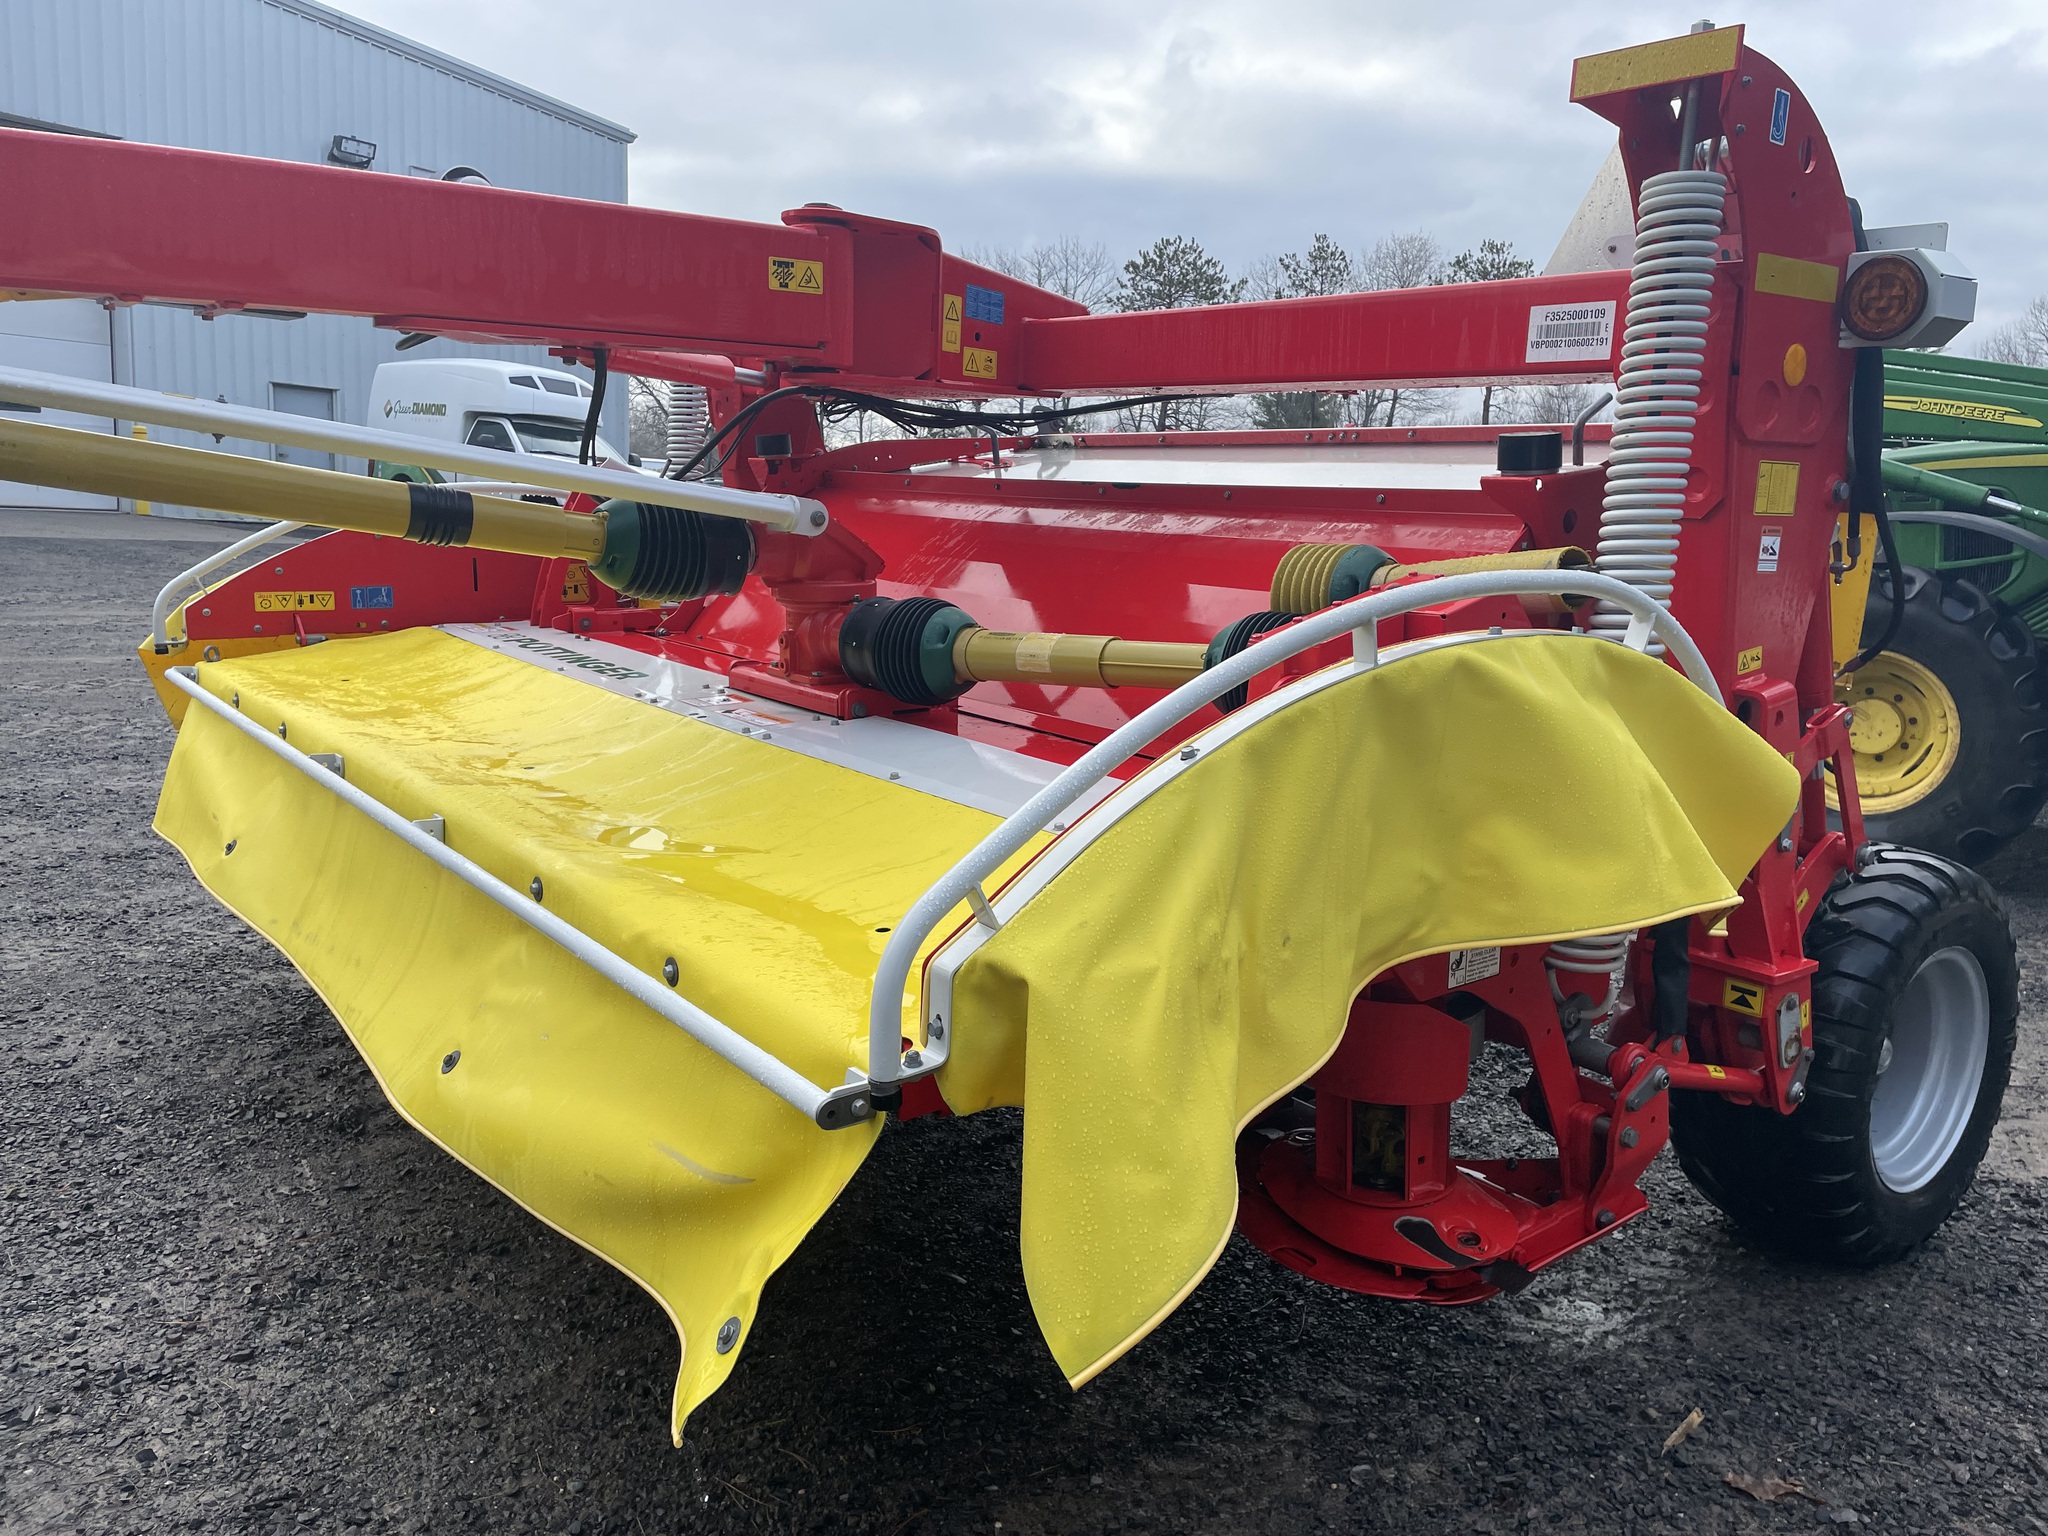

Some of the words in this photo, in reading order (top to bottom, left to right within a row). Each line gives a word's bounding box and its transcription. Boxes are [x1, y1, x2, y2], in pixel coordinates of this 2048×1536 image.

[1545, 308, 1606, 322] F3525000109
[1605, 323, 1609, 333] E
[1531, 337, 1609, 349] VBP00021006002191
[394, 400, 413, 419] Green
[412, 403, 447, 416] DIAMOND
[1912, 399, 1951, 414] JOHN
[1952, 404, 2006, 421] DEERE
